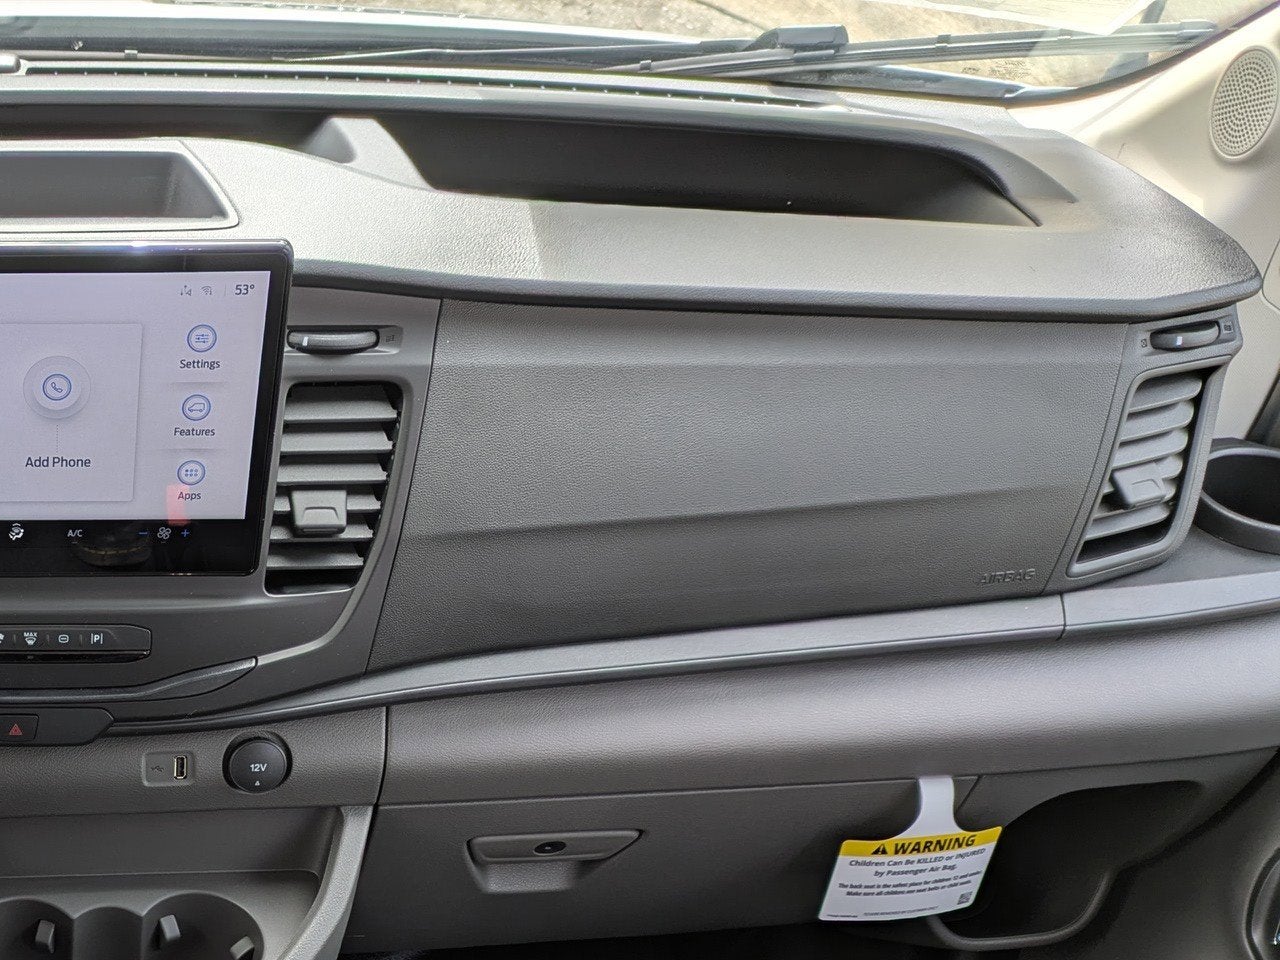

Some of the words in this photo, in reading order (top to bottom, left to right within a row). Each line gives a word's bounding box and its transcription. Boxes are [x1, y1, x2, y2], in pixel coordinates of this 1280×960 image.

[234, 283, 256, 296] 53°
[179, 358, 221, 371] Settings
[173, 426, 216, 437] Features
[25, 455, 50, 468] Add
[52, 455, 91, 468] Phone
[177, 490, 202, 501] Apps
[67, 529, 83, 538] A/C
[980, 568, 1036, 584] AIRBAG
[249, 763, 268, 772] 12V
[893, 834, 977, 856] WARNING
[849, 858, 886, 867] Children
[887, 859, 903, 867] Can
[904, 857, 916, 866] Be
[916, 855, 944, 865] KILLED
[955, 847, 987, 861] INJURED
[874, 869, 885, 877] by
[886, 867, 928, 876] Passenger
